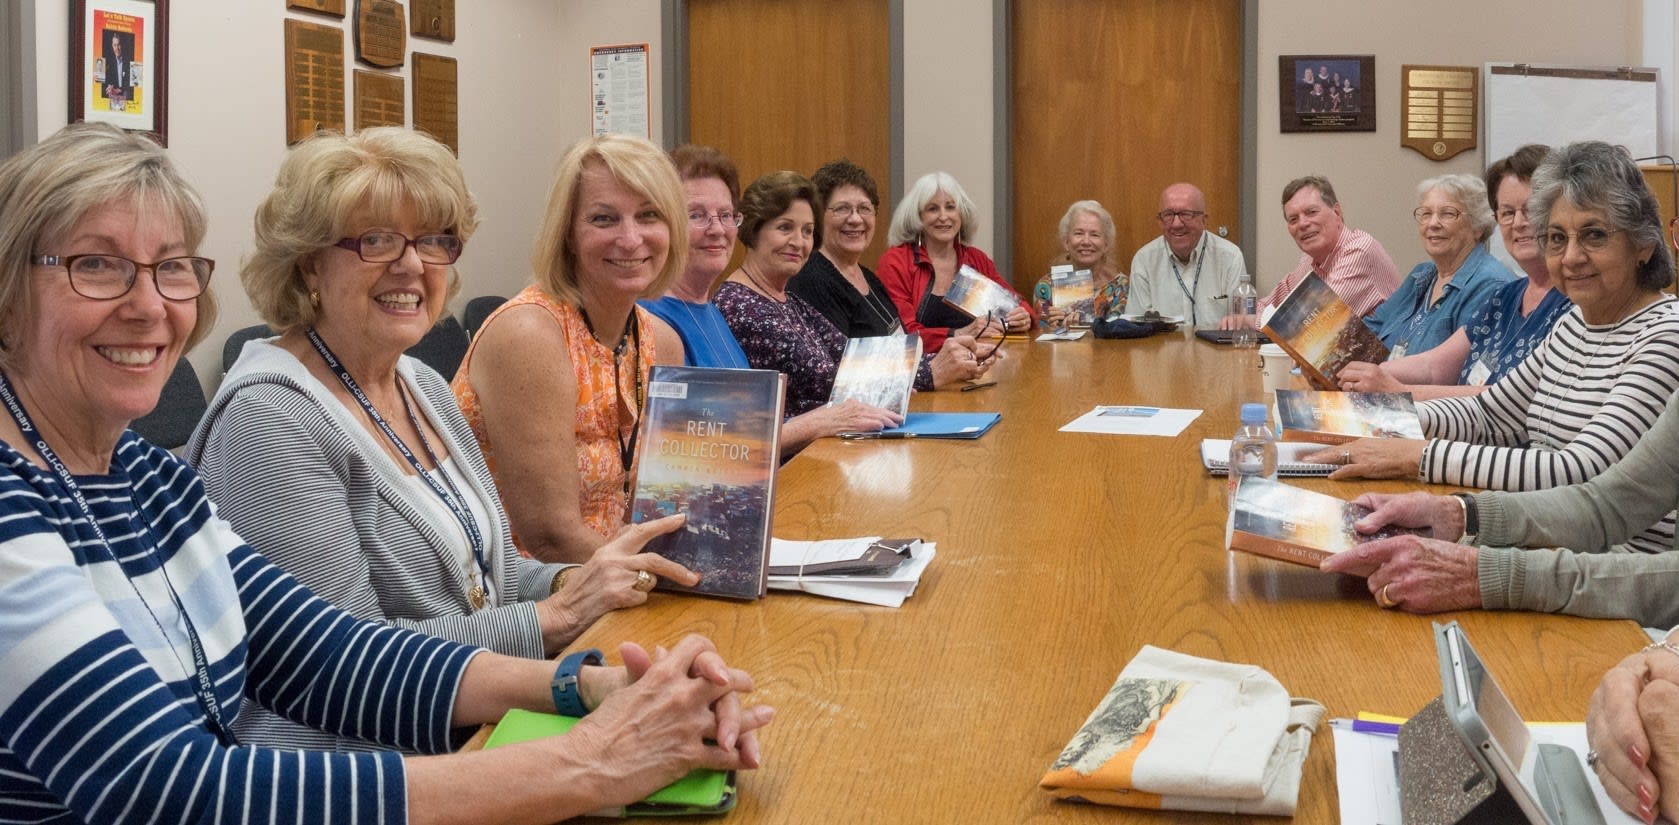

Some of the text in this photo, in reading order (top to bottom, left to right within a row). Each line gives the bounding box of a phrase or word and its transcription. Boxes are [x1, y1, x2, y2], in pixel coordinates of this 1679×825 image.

[341, 372, 371, 409] OLLI-CSUF
[379, 421, 411, 457] Anniversary
[702, 407, 715, 417] The
[687, 420, 728, 437] RENT
[660, 439, 750, 461] COLLECTOR
[36, 440, 77, 490] OLLI-CSUF
[73, 489, 89, 515] 35th
[198, 670, 211, 690] 35th
